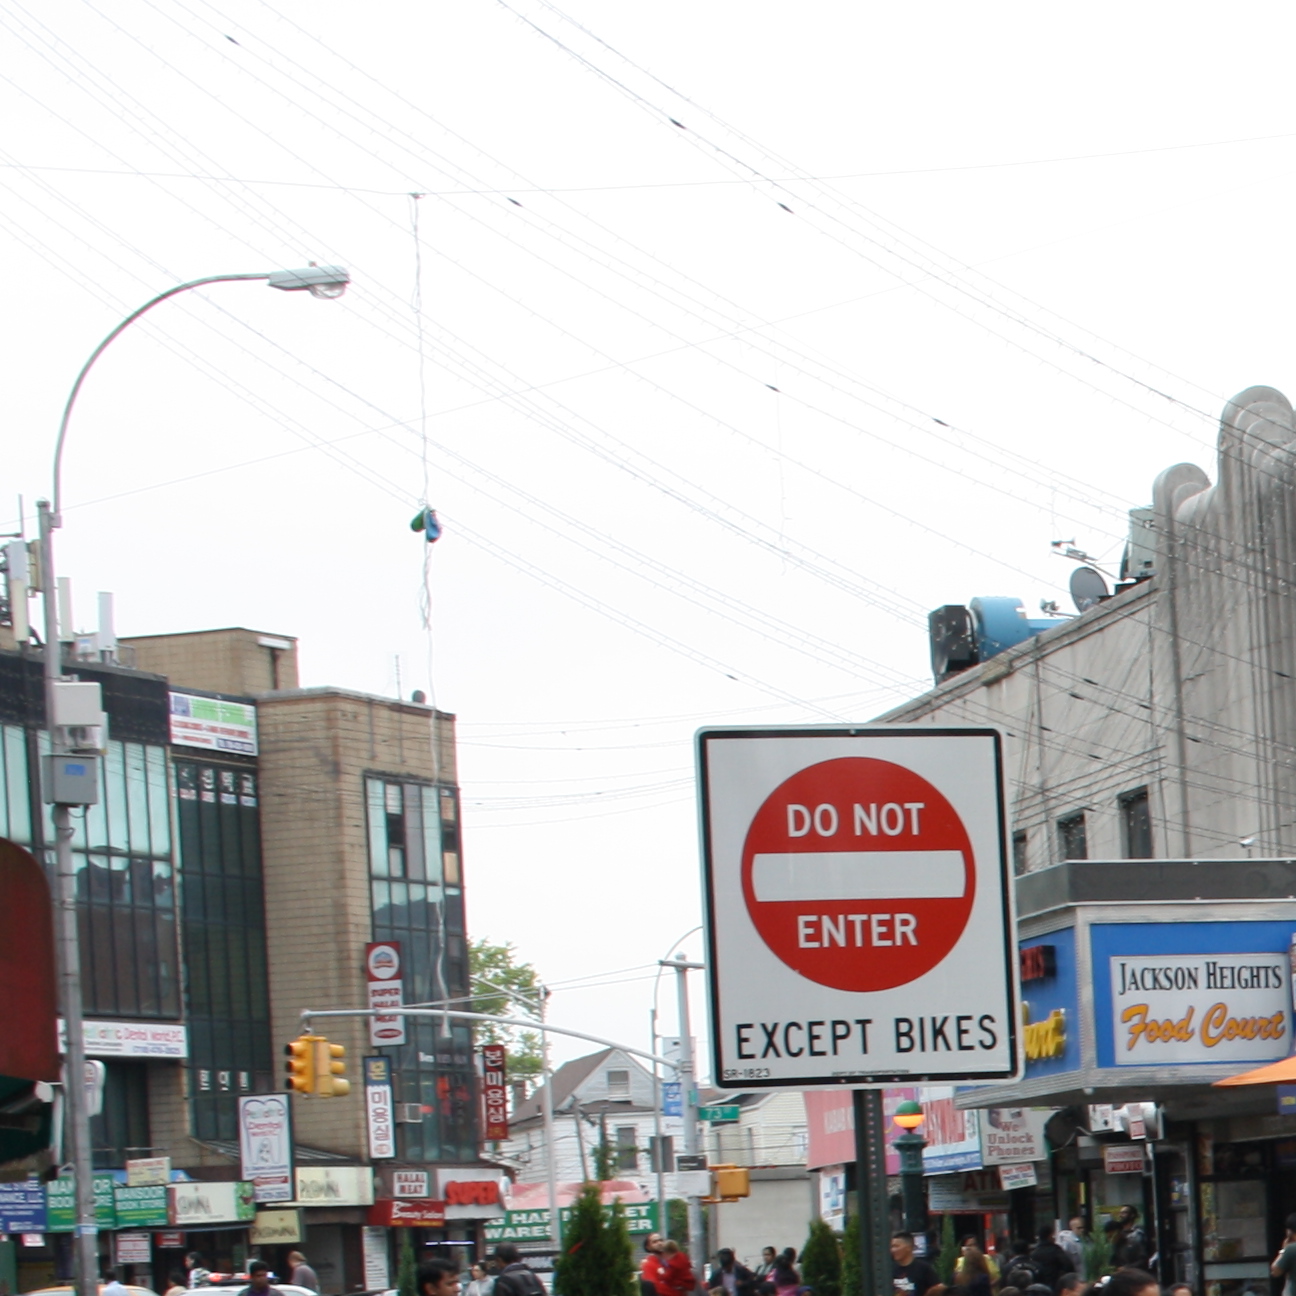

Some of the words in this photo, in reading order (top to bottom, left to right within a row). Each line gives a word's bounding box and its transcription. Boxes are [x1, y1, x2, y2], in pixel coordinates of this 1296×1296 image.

[787, 803, 839, 837] DO
[853, 802, 925, 836] NOT
[797, 912, 918, 949] ENTER
[1119, 962, 1199, 995] JACKSON
[1205, 961, 1283, 990] HEIGHTS
[736, 1018, 873, 1060] EXCEPT
[895, 1014, 998, 1055] BIKES
[1121, 1003, 1195, 1051] Food
[1200, 1002, 1286, 1048] Court
[987, 1132, 1035, 1145] Unlock
[987, 1145, 1036, 1157] Phones
